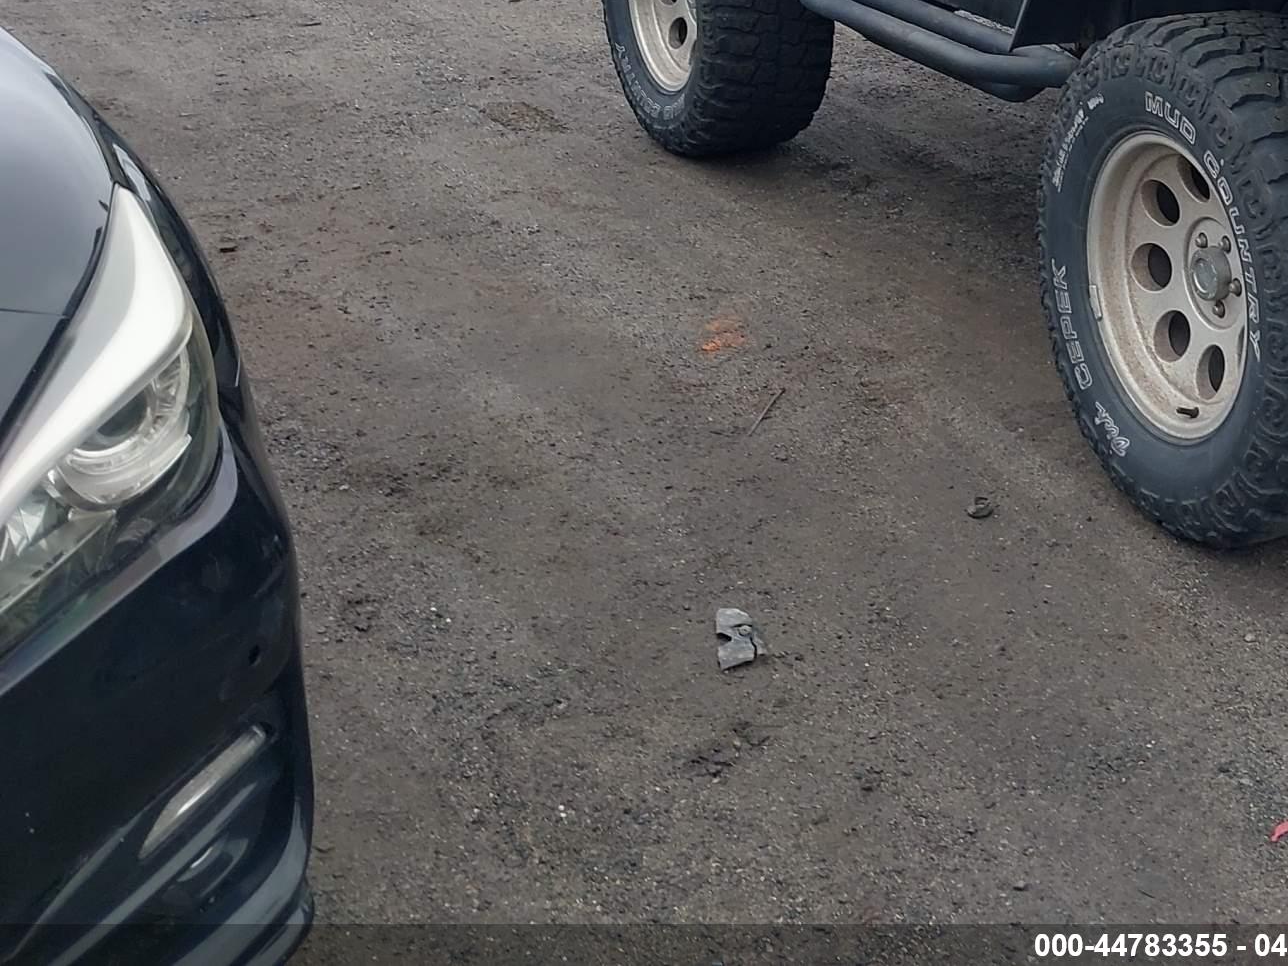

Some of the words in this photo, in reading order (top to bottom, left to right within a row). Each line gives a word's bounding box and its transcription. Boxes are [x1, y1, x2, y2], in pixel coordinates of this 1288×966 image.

[1051, 258, 1093, 391] CEPEK
[1145, 91, 1197, 145] MUD
[1203, 150, 1261, 362] COUNTRY
